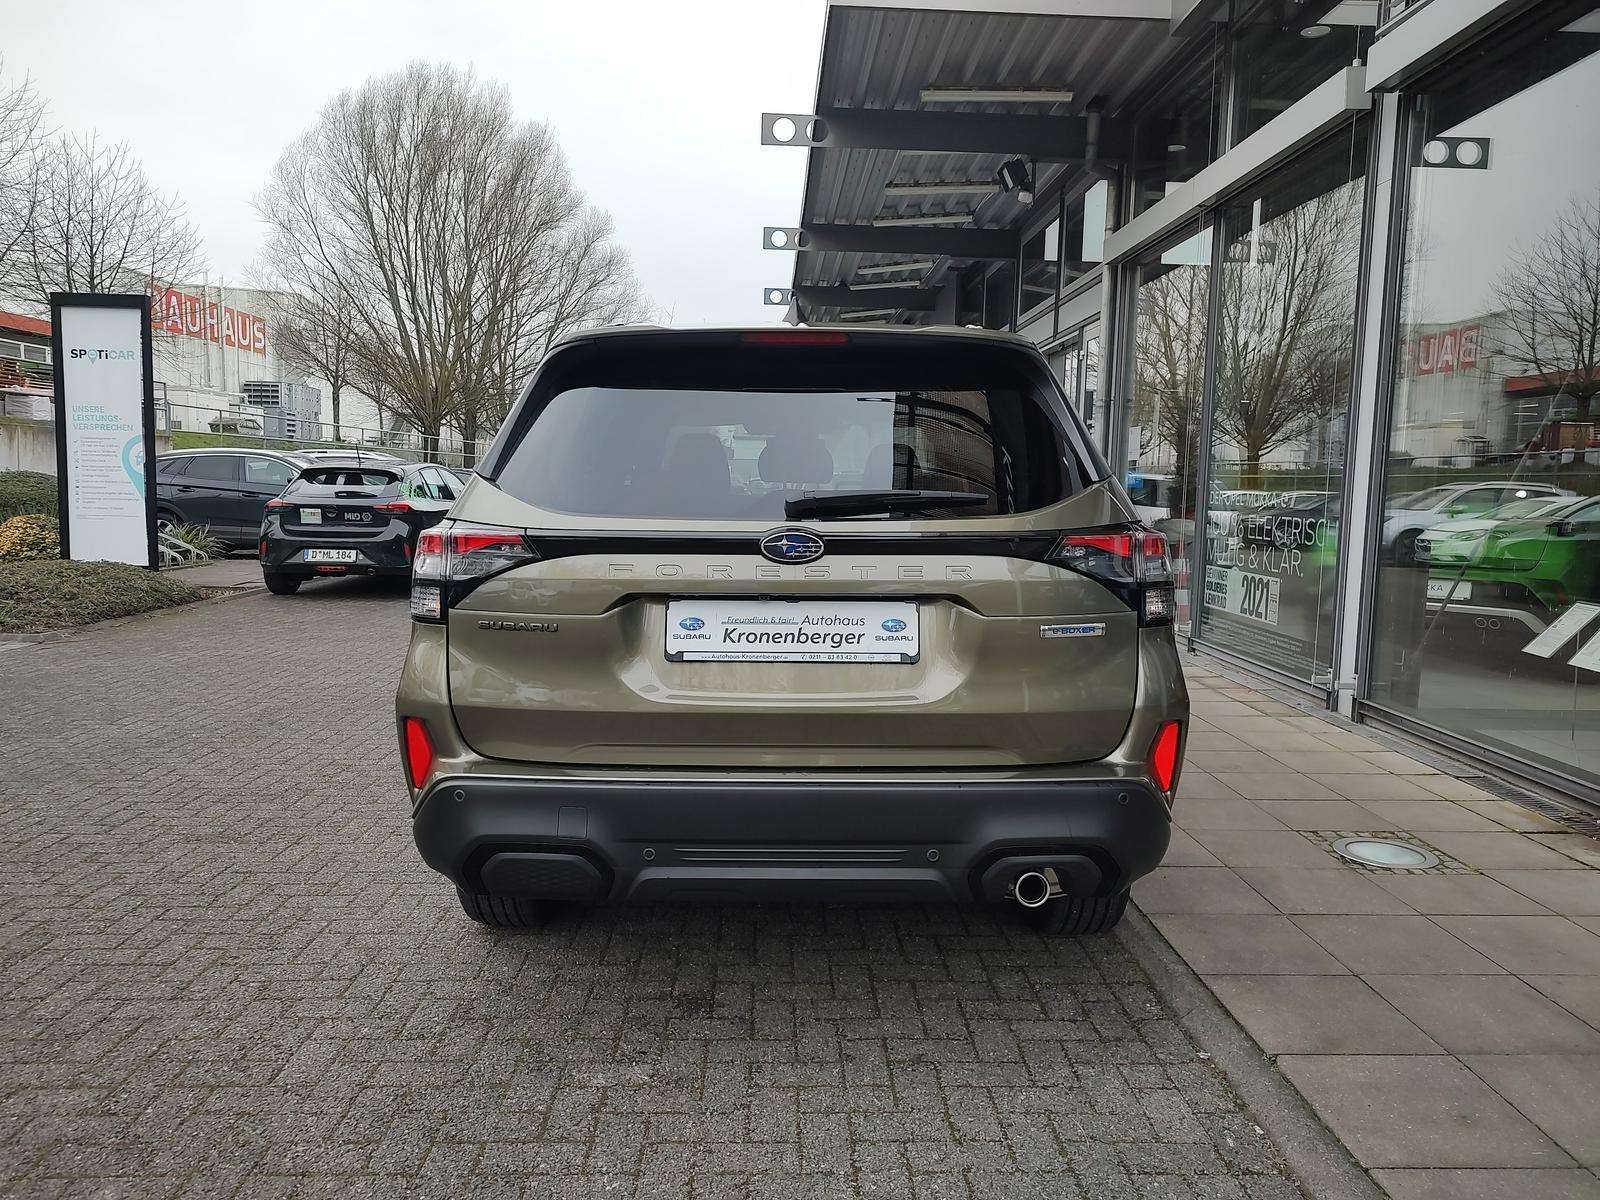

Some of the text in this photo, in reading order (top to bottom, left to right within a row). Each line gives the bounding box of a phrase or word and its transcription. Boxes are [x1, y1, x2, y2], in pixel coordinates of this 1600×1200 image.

[72, 405, 105, 413] UNSERE
[72, 414, 122, 422] LEISTUNGS-
[73, 423, 134, 431] VERSPRECHEN
[1248, 514, 1339, 550] ELEKTRISCH
[336, 550, 352, 559] 184
[1249, 544, 1258, 569] &
[1263, 546, 1303, 577] KLAR.
[608, 563, 975, 580] FORESTER
[1240, 574, 1270, 620] 2021
[478, 620, 559, 632] SUBARU
[727, 615, 768, 624] Freundlich
[778, 615, 795, 625] fair!
[801, 614, 866, 626] Autohaus
[1053, 626, 1096, 634] e-BOXER
[723, 627, 865, 648] Kronenberger
